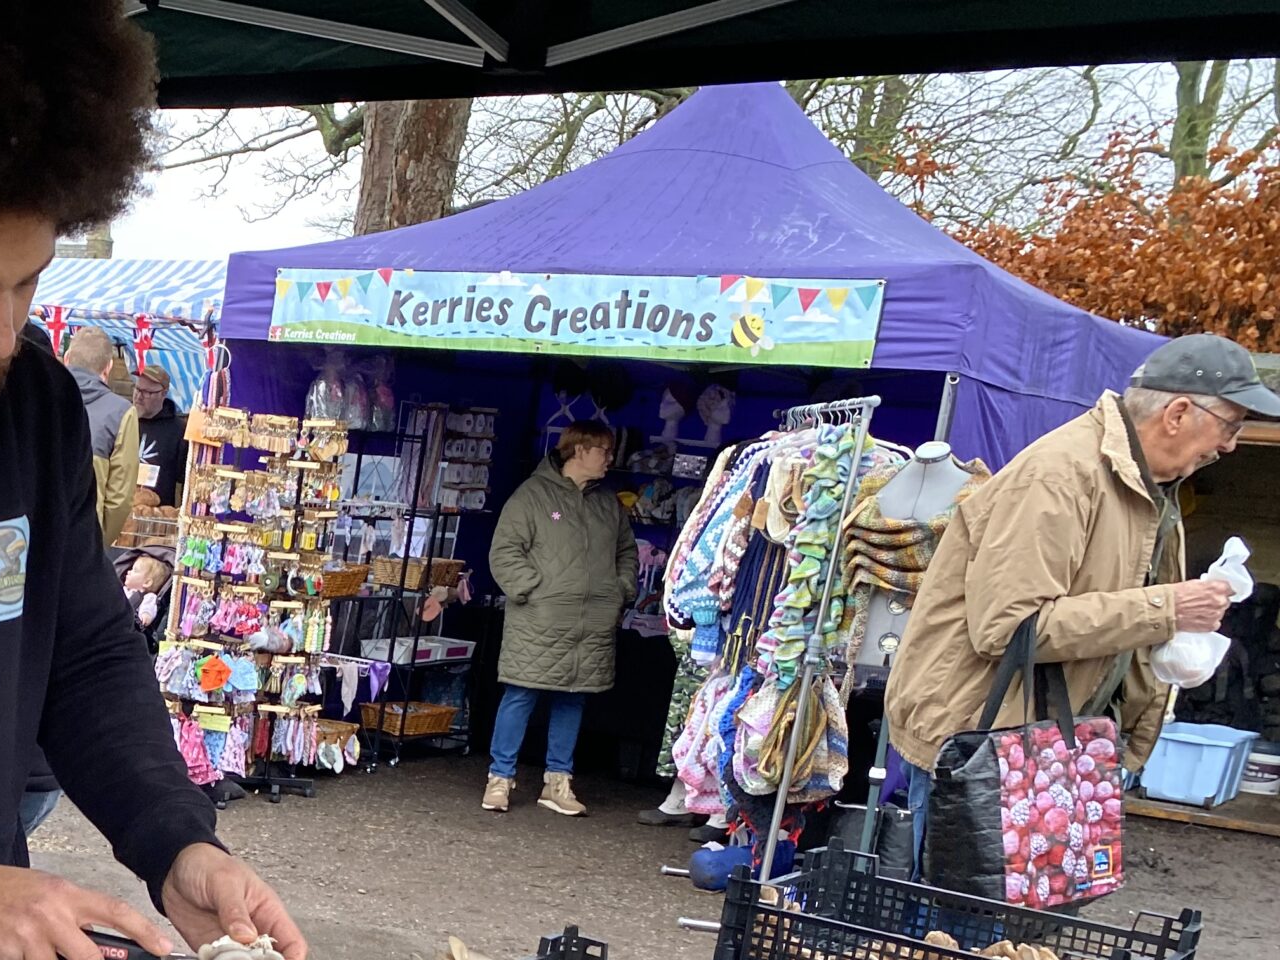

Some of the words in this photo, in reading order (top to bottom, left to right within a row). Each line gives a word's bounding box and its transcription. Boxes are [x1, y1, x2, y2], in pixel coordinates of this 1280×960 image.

[386, 285, 514, 327] Kerries
[524, 289, 717, 342] Creations
[284, 327, 313, 339] Kerries
[316, 328, 356, 341] Creations
